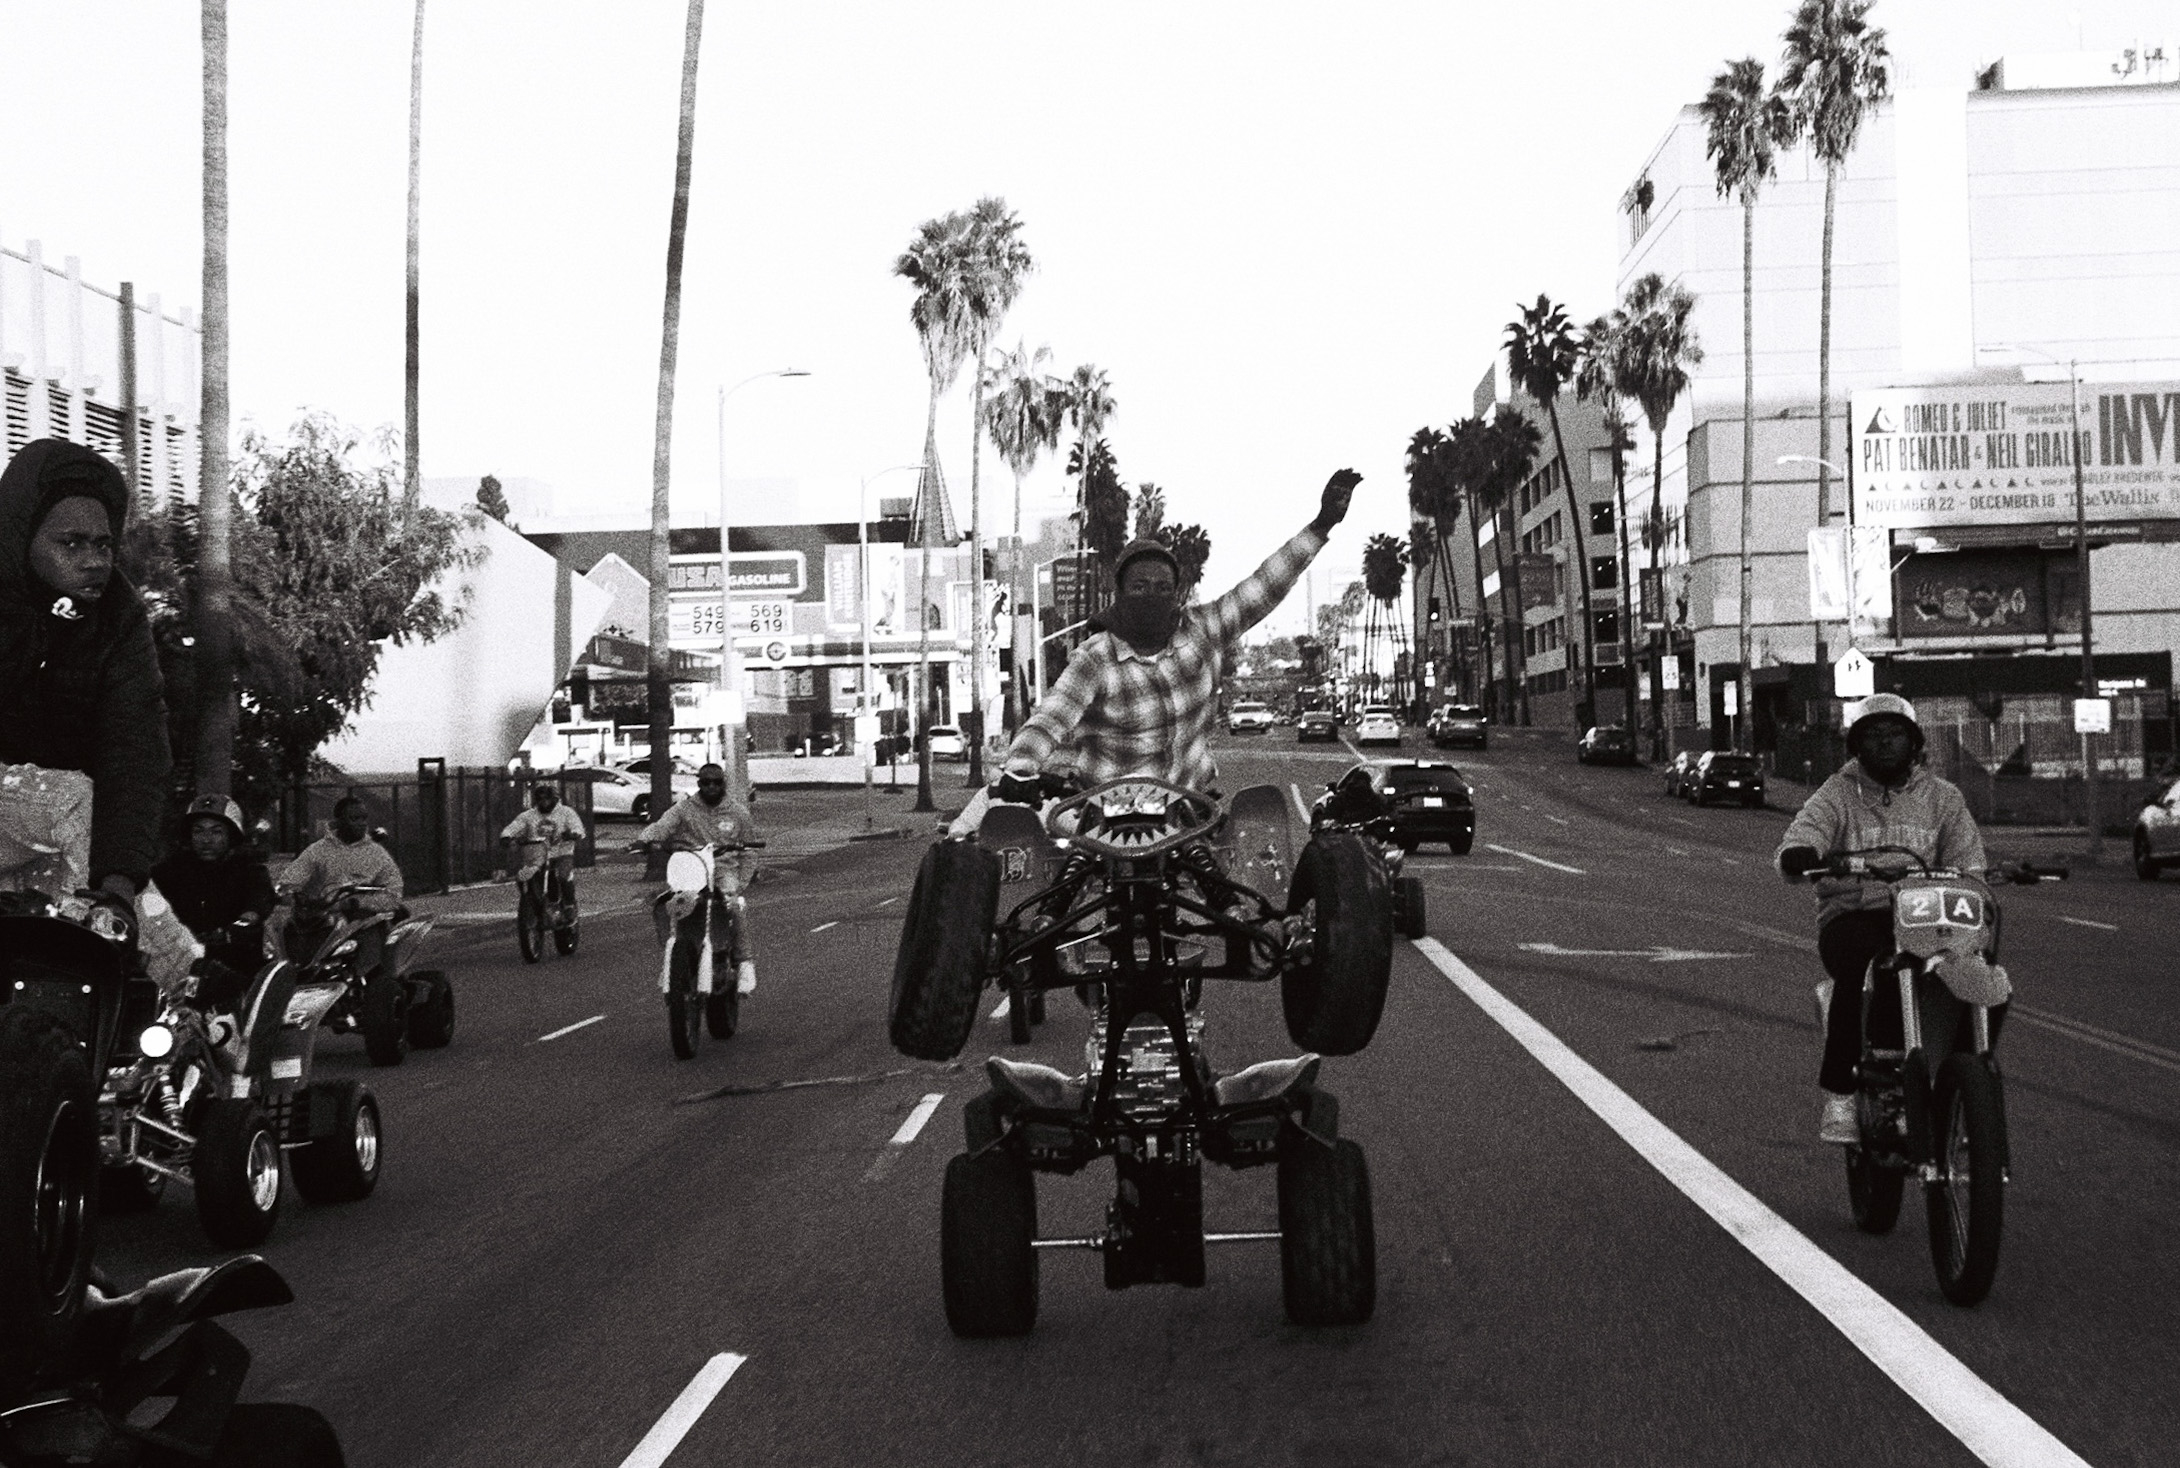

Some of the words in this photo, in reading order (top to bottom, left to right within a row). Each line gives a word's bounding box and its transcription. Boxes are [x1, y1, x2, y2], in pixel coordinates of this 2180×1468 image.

[1904, 403, 1947, 433] ROMEO
[1967, 401, 2006, 431] JULIET
[1864, 438, 1891, 472] PAT
[1899, 434, 1970, 471] BENATAR
[1986, 433, 2019, 469] NEIL
[2026, 430, 2092, 467] GIRALO
[1866, 497, 1936, 513] NOVEMBER
[1939, 496, 1954, 511] 22
[1969, 493, 2039, 510] DECEMBER
[728, 573, 791, 586] GASOLINE
[693, 605, 724, 620] 549
[750, 604, 782, 618] 569
[693, 620, 724, 634] 579
[750, 619, 782, 633] 619
